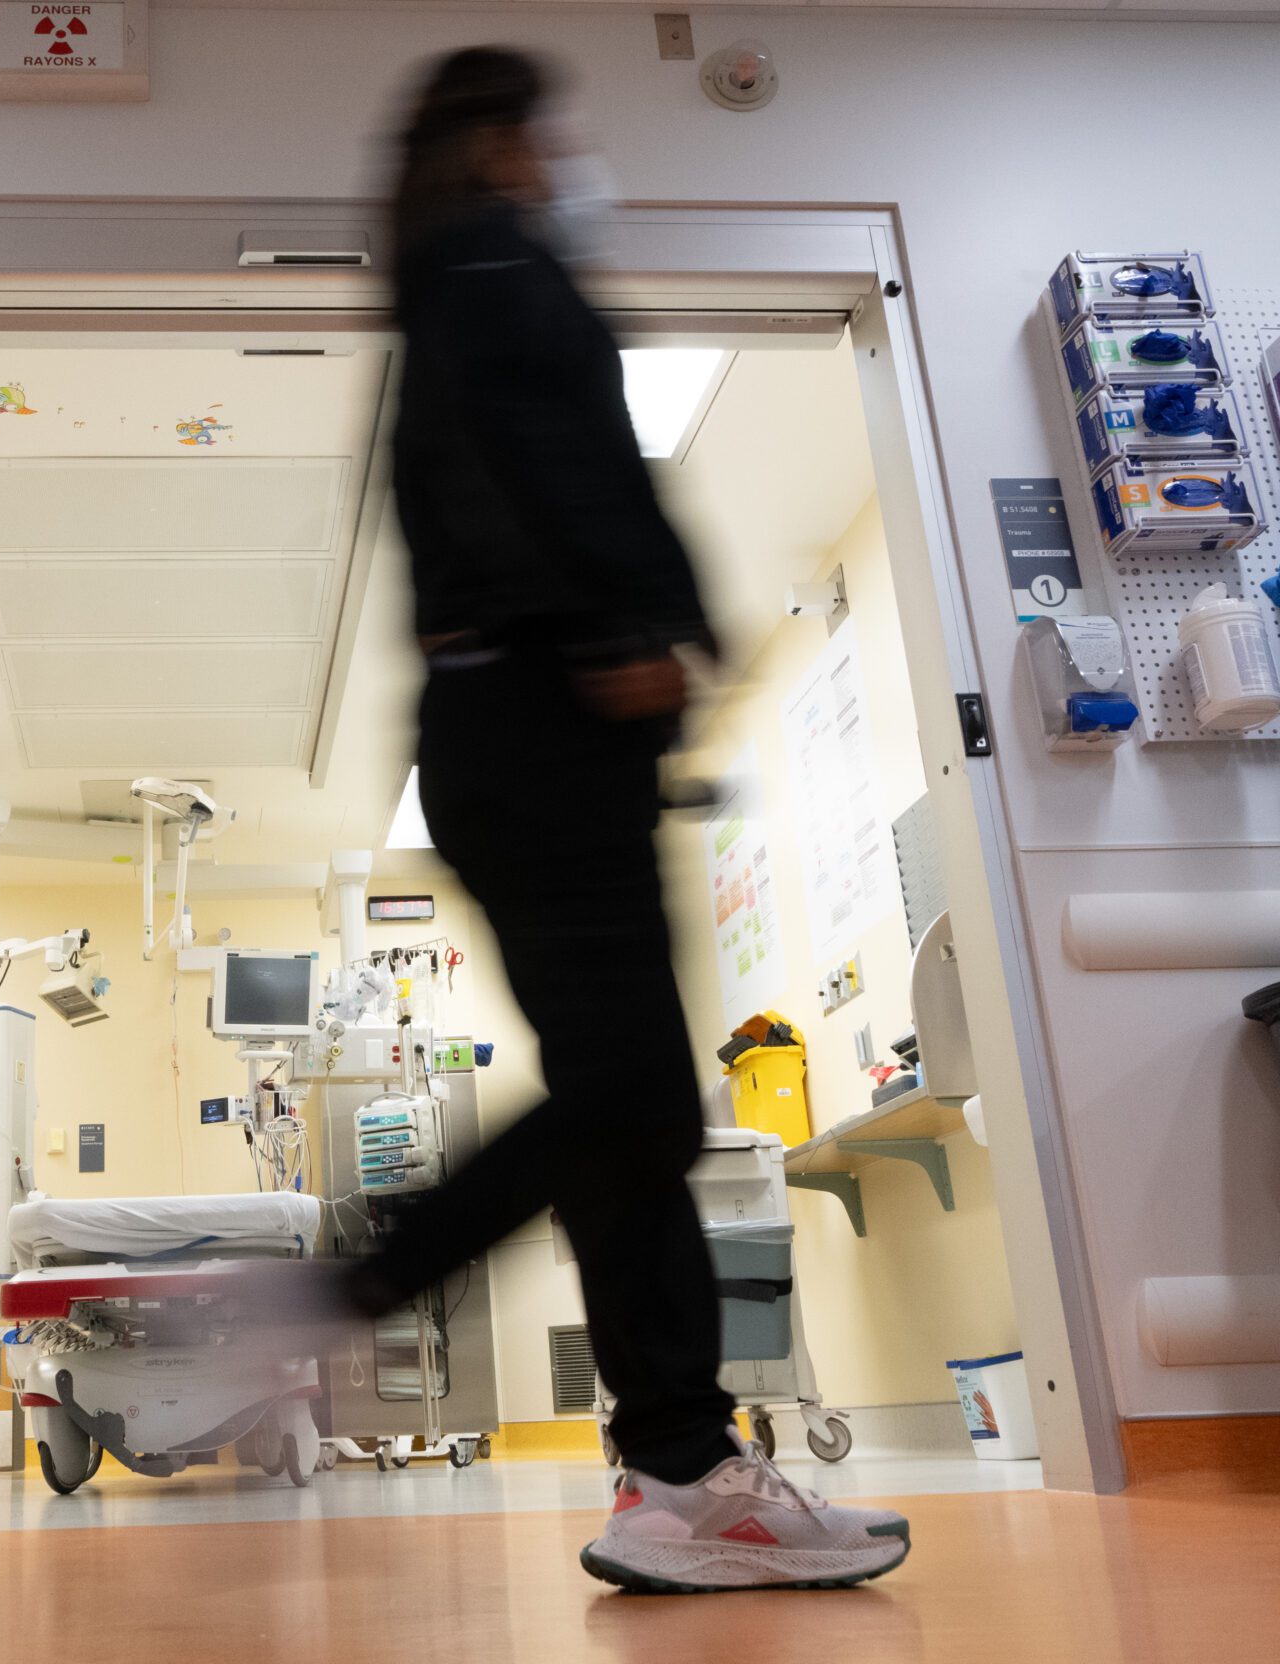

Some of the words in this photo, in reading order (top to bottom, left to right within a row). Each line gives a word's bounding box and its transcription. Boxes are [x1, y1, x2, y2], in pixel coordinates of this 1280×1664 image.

[31, 5, 91, 15] DANGER
[23, 56, 84, 66] RAYONS
[88, 56, 97, 66] X
[1112, 411, 1130, 427] M
[1128, 487, 1142, 500] S
[1040, 579, 1053, 601] 1
